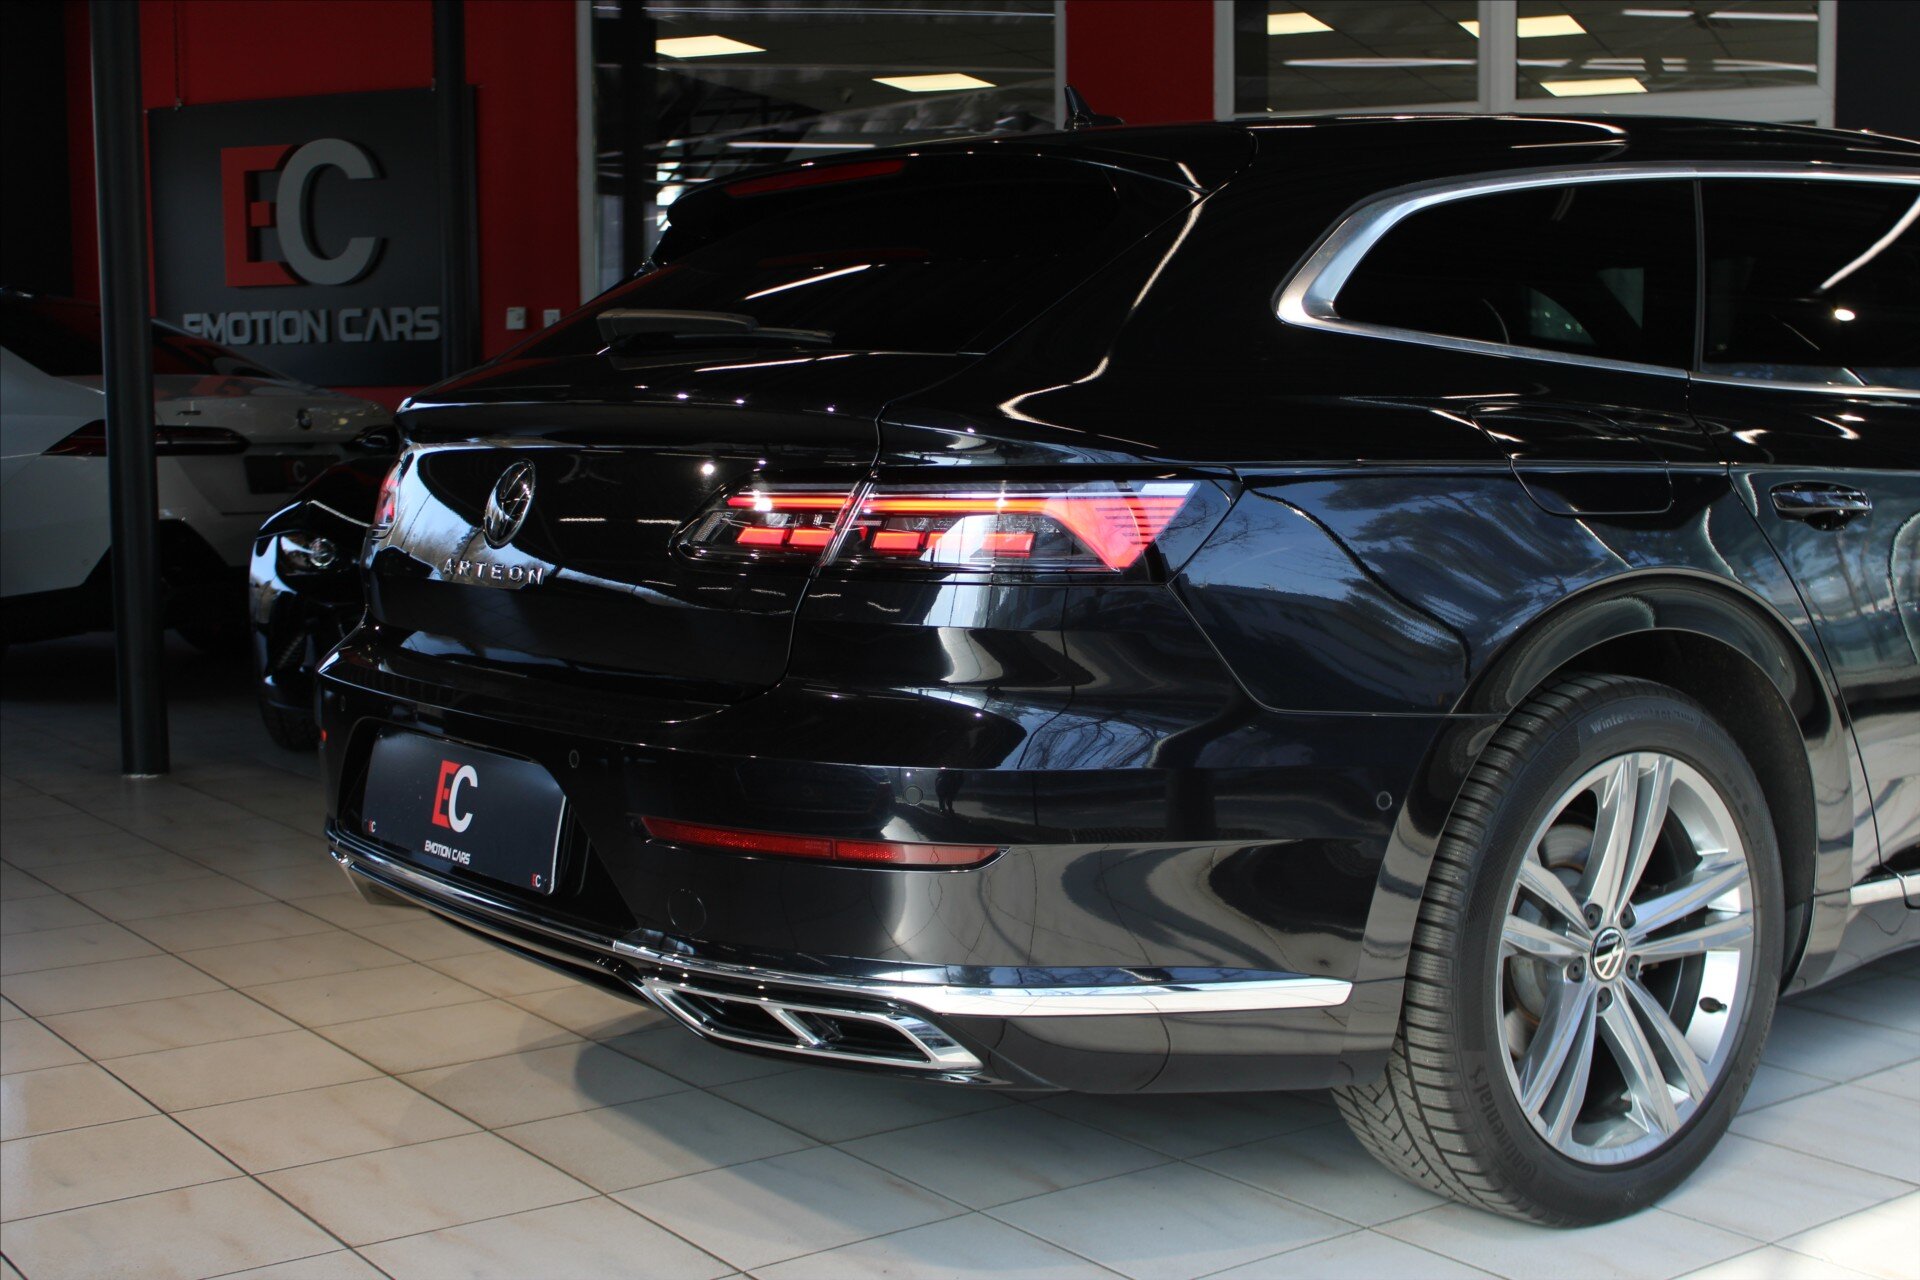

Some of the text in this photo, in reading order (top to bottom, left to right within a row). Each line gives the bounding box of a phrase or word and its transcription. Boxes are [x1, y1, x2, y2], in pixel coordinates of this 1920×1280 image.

[220, 137, 378, 287] EC
[183, 305, 441, 346] EMOTION CARS
[442, 558, 544, 584] ARTEON
[431, 759, 479, 833] EC
[424, 839, 471, 866] EMOTION CARS
